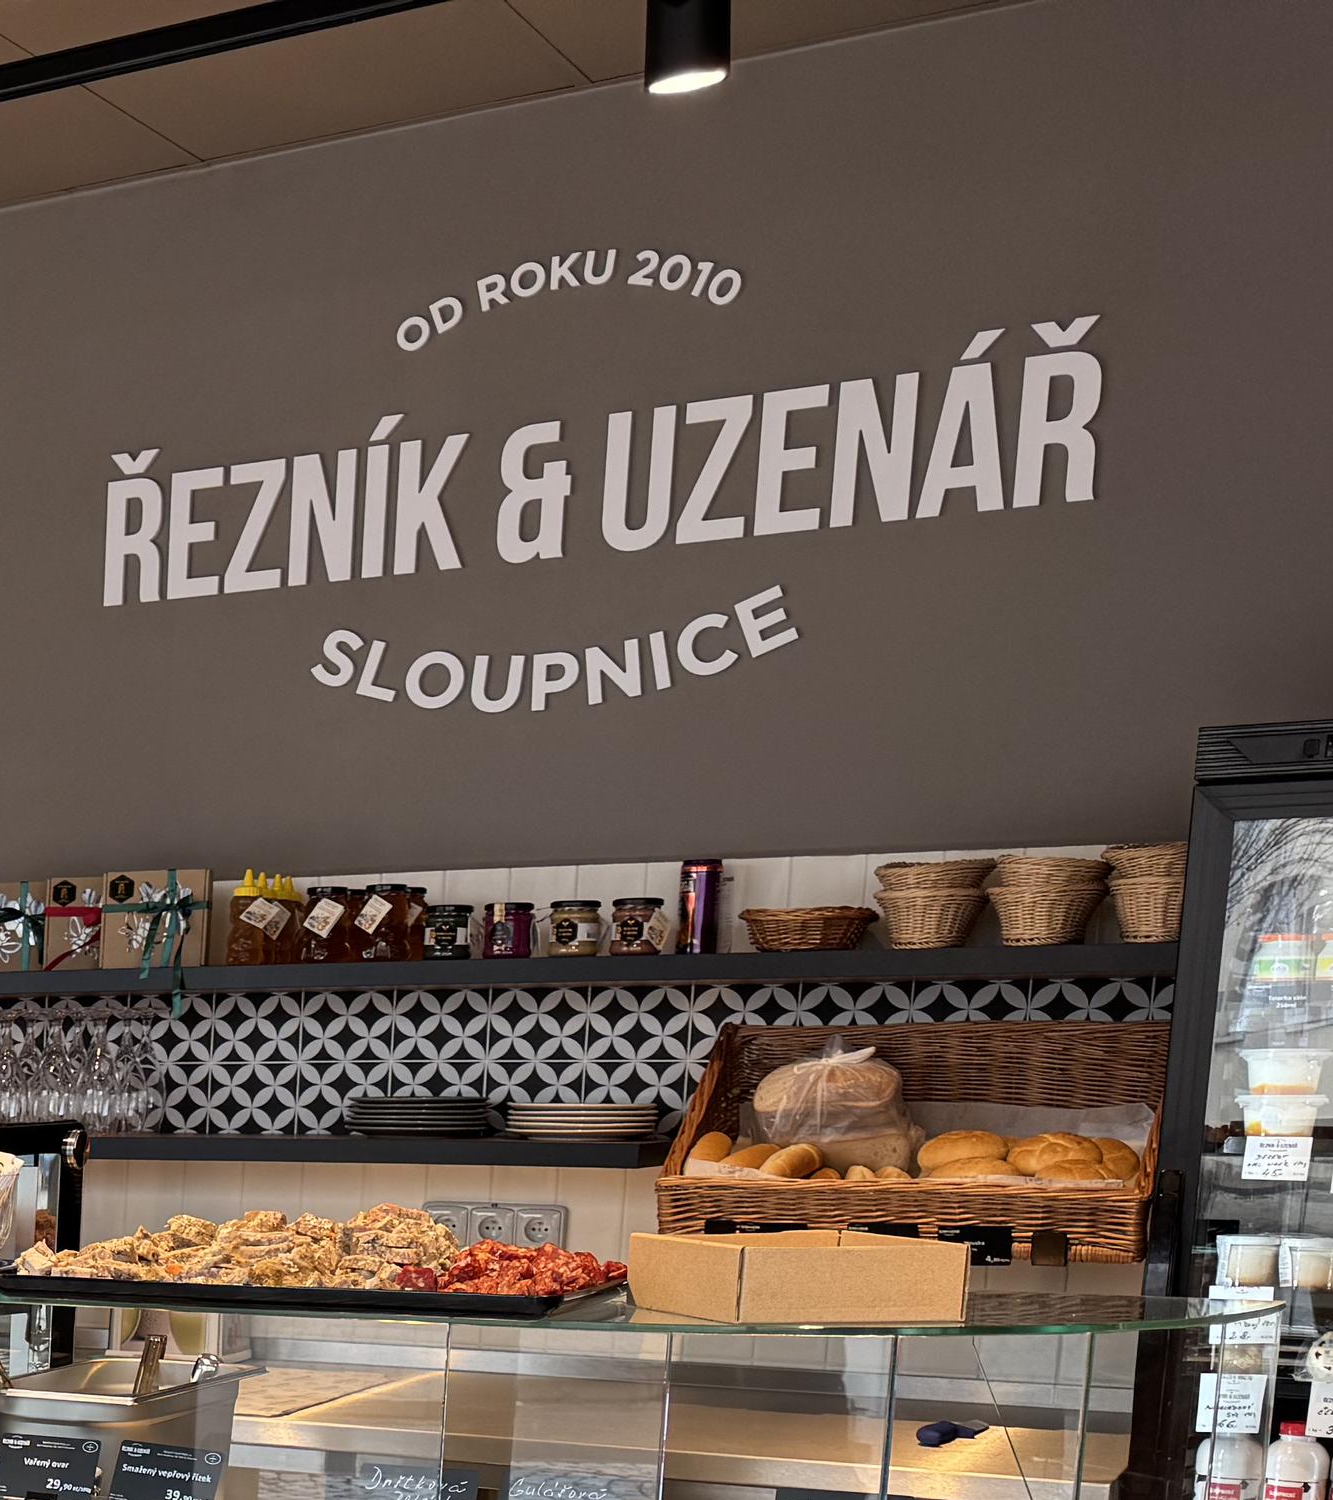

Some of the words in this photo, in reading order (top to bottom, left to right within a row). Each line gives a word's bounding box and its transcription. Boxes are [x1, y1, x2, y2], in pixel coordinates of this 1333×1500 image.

[397, 296, 463, 351] OD
[476, 249, 616, 312] ROKU
[627, 249, 743, 306] 2010
[102, 414, 471, 607] ŘEZNÍK
[495, 420, 573, 564] &
[600, 314, 1102, 552] UZENÁŘ
[309, 584, 800, 713] SLOUPNICE
[24, 1457, 51, 1469] Vařený
[51, 1461, 70, 1469] ovar
[122, 1463, 158, 1477] Smažený
[158, 1469, 191, 1482] vepřový
[191, 1473, 212, 1483] řízek
